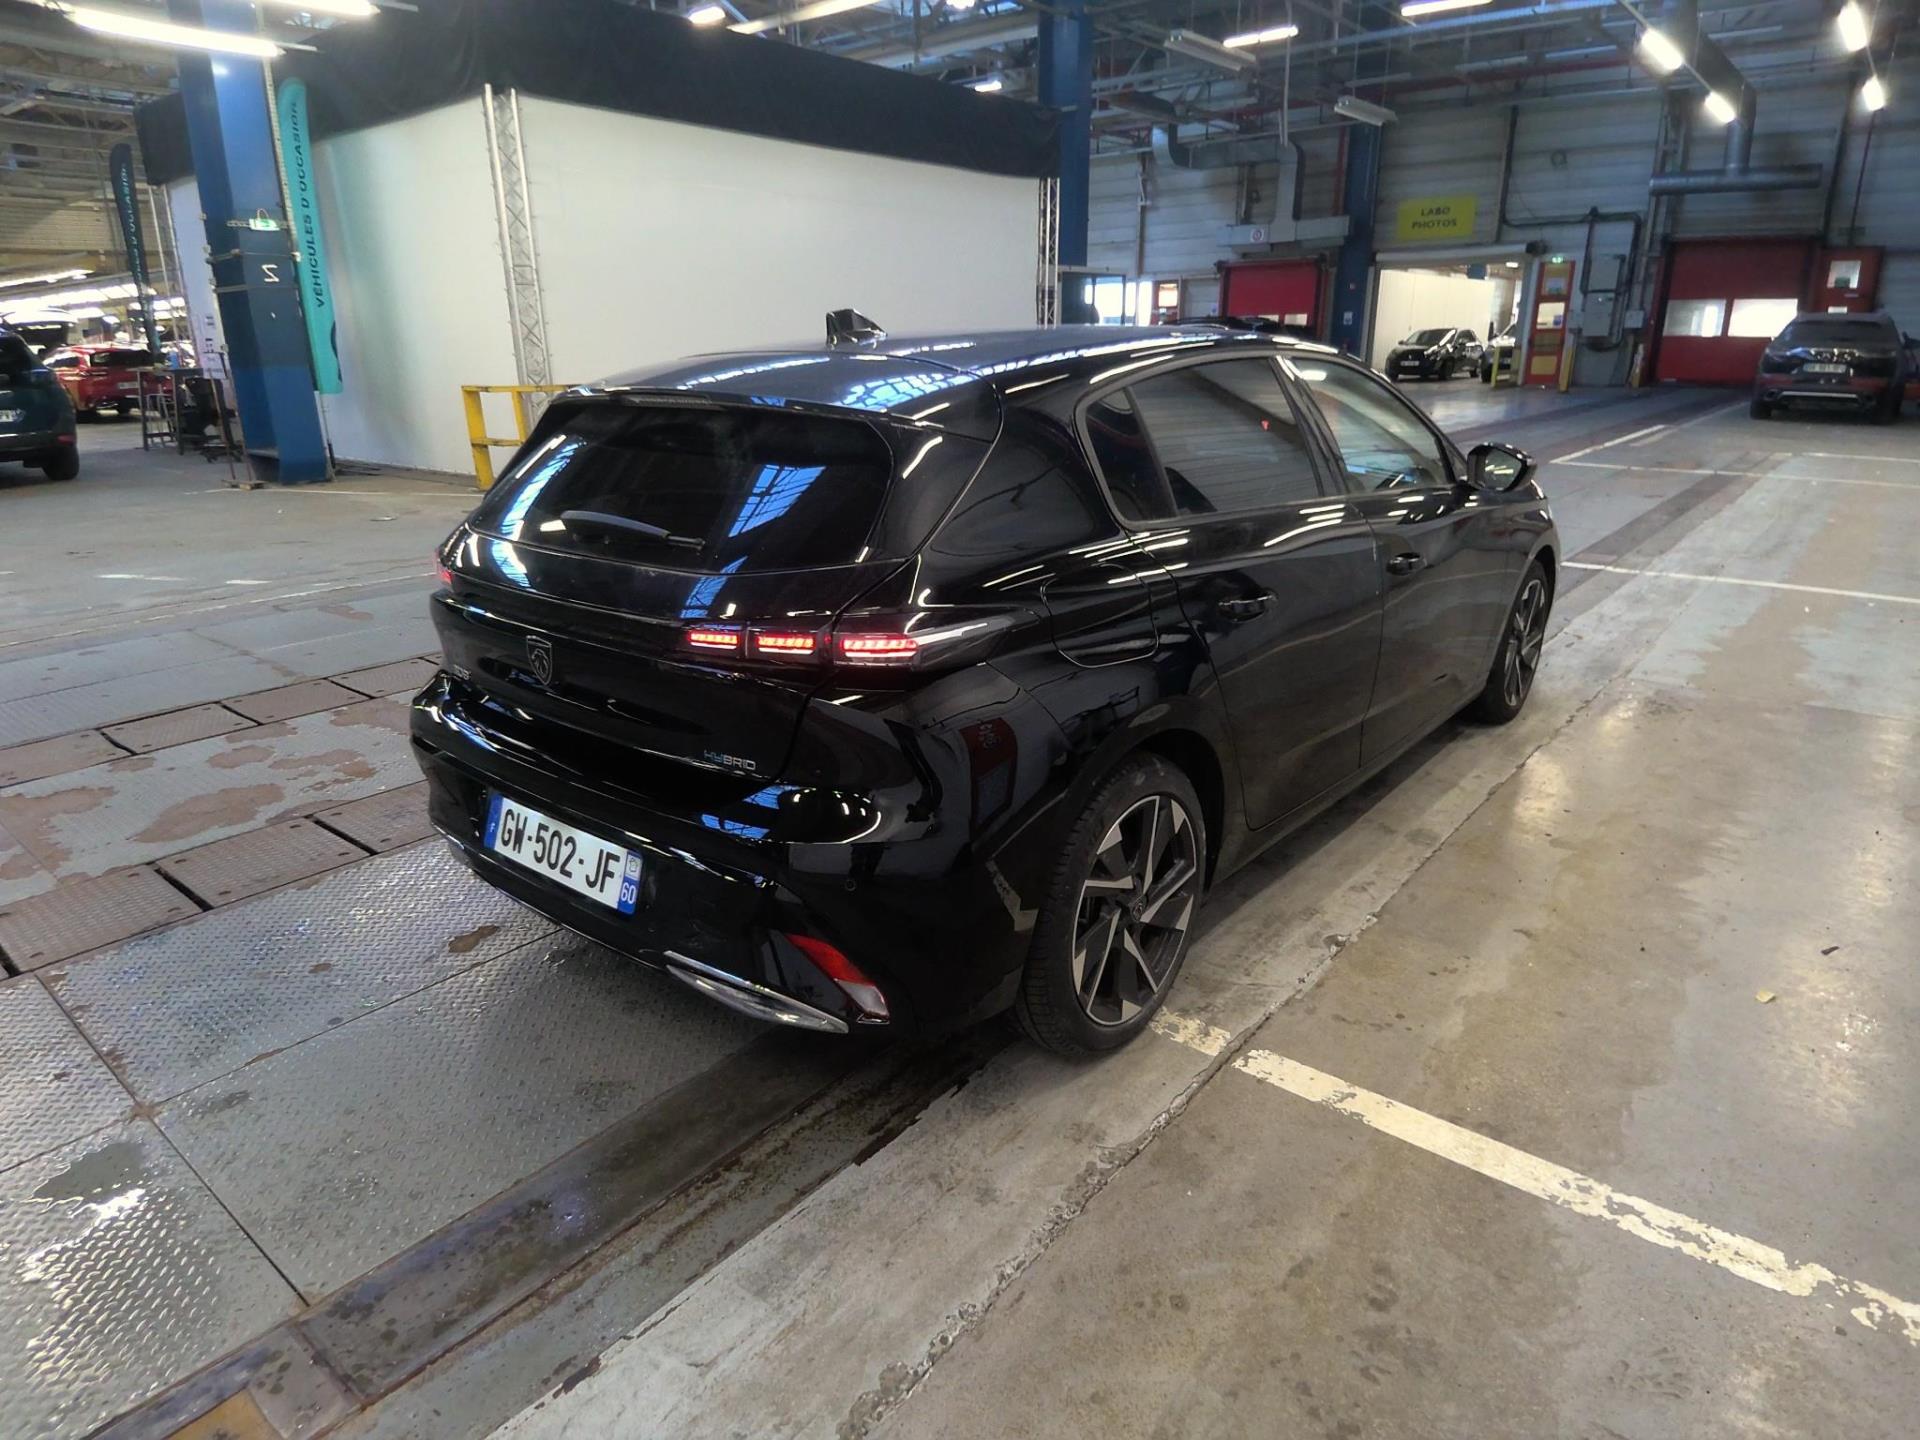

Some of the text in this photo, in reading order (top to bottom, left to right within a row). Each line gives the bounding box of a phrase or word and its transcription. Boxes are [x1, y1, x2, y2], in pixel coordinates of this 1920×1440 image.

[1421, 207, 1451, 217] LABO
[1411, 218, 1457, 230] PHOTOS
[703, 749, 756, 770] HYBRID
[501, 809, 621, 893] GW-502-JF
[620, 882, 636, 905] 60
